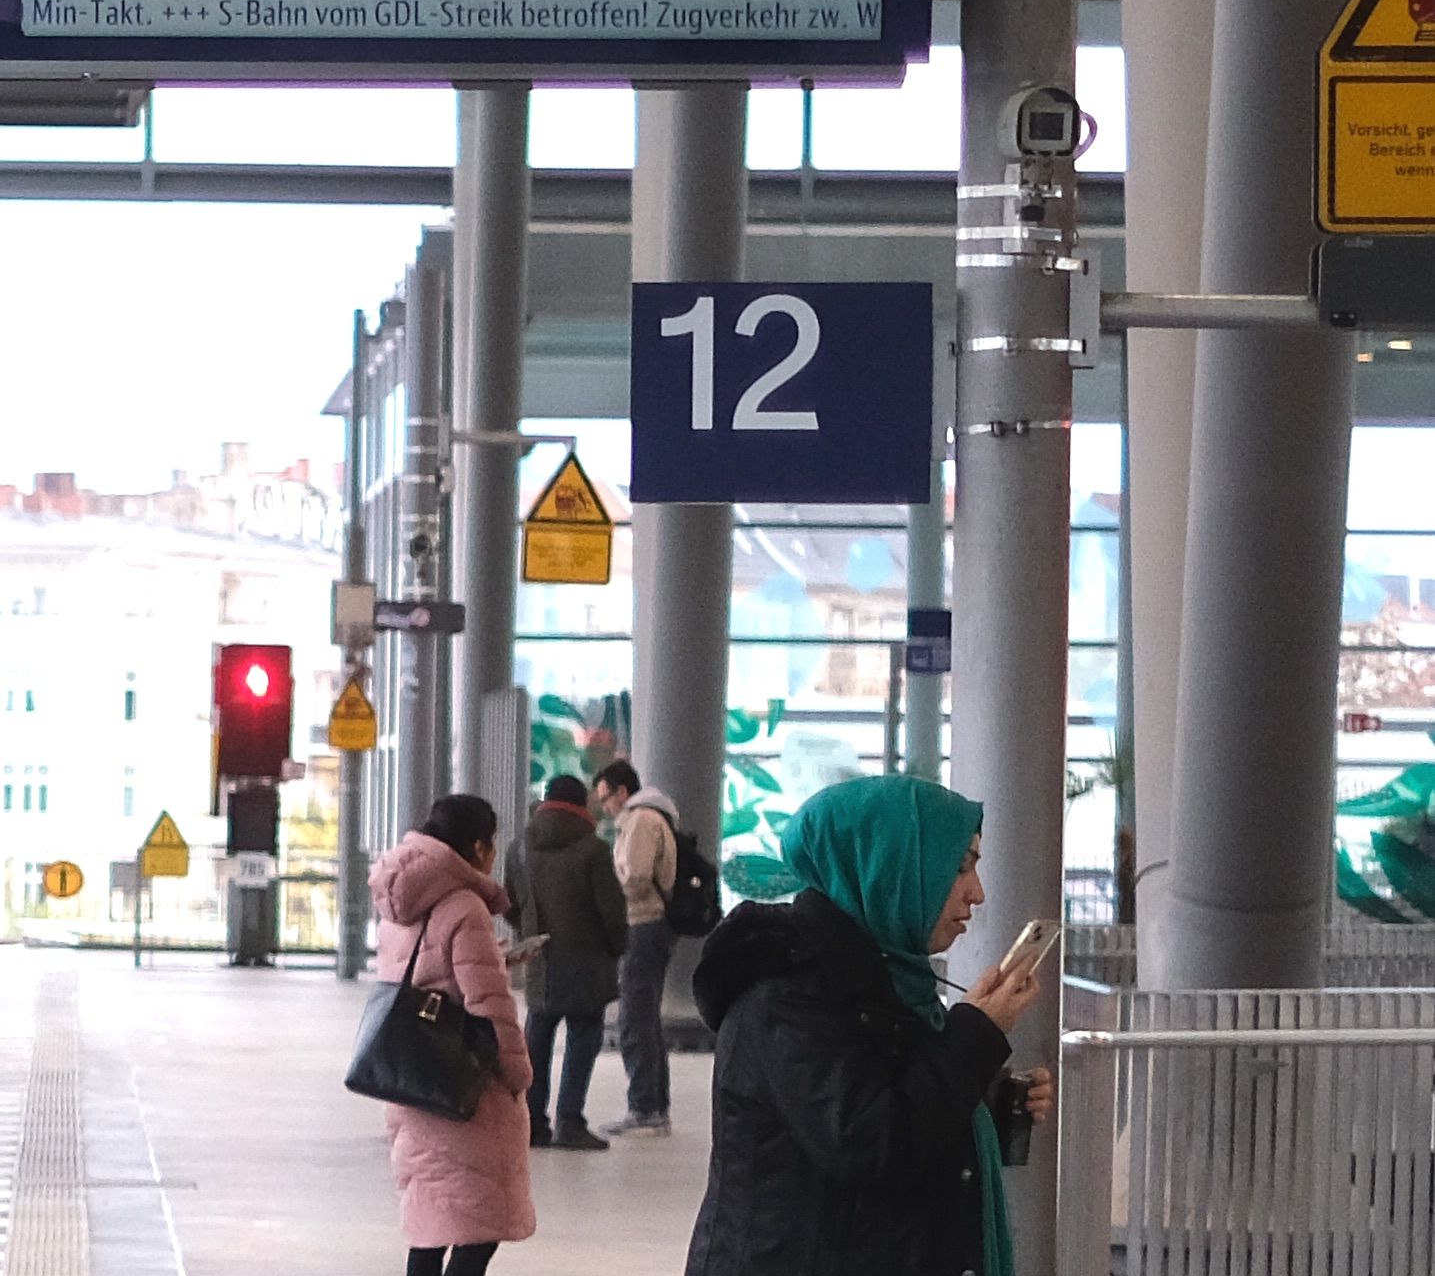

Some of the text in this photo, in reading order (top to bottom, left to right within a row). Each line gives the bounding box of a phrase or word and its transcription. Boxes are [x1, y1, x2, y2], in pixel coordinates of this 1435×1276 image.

[161, 6, 209, 21] +++
[316, 7, 367, 27] vom
[375, 0, 512, 28] GDL-Streik
[522, 0, 648, 28] betroffen!
[656, 1, 800, 35] Zugverkehr
[808, 9, 848, 29] zw.
[857, 2, 879, 29] W
[1369, 142, 1426, 157] Bereich
[661, 294, 820, 430] 12
